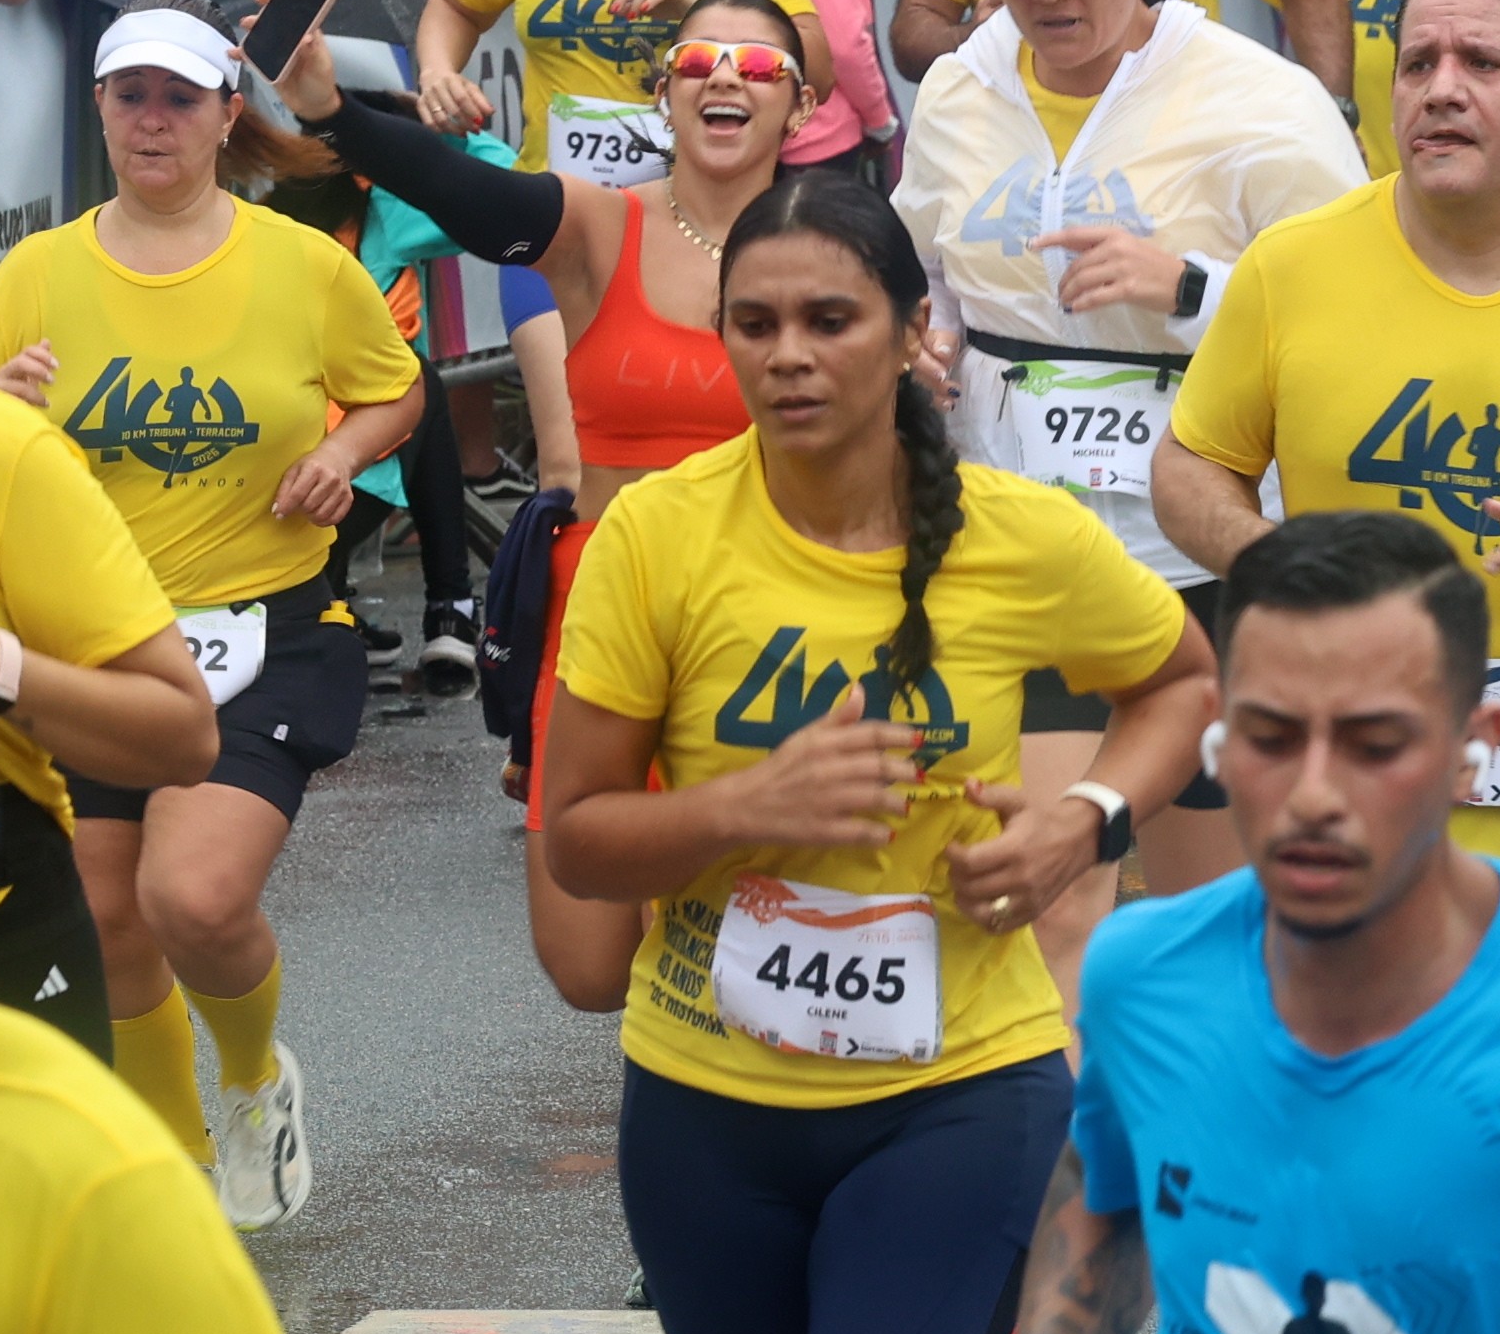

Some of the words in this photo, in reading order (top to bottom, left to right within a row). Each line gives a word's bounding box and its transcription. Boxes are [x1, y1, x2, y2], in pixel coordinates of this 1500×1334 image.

[566, 130, 644, 165] 9736
[122, 430, 131, 441] 10
[132, 429, 147, 440] KM
[149, 427, 186, 438] TRIBUNA
[195, 425, 244, 437] TERRACOM
[1044, 407, 1151, 448] 9726
[191, 448, 220, 467] 2026
[1072, 448, 1116, 458] MICHELLE
[180, 478, 245, 488] ANOS
[1449, 471, 1491, 487] TRIBUNA
[757, 943, 906, 1004] 4465
[806, 1005, 848, 1021] CILENE
